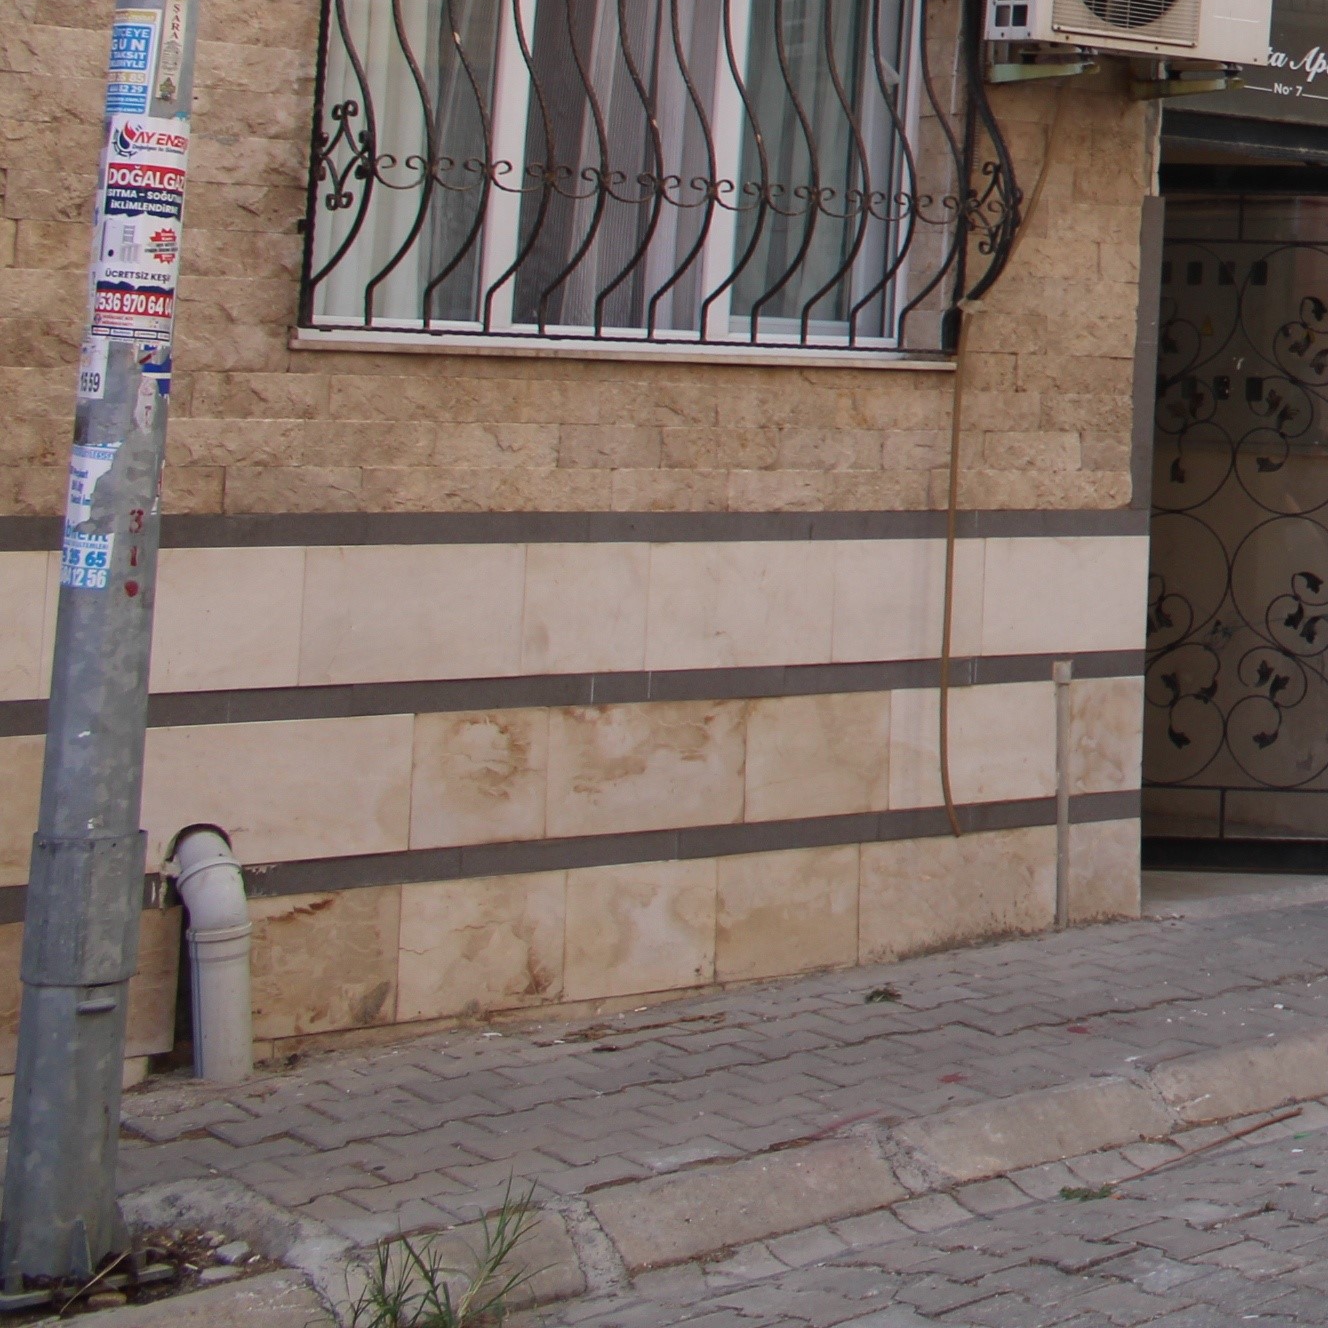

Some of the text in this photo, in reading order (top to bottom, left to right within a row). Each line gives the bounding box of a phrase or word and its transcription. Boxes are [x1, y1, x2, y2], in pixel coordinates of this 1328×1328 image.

[1295, 85, 1303, 97] 7
[107, 189, 137, 198] SITMA
[147, 188, 182, 203] SOĞUT
[105, 268, 171, 284] ÜCRETSİZ KEŞİ
[95, 292, 121, 310] 536
[123, 293, 146, 313] 970
[147, 296, 163, 315] 64
[85, 550, 107, 568] 65
[86, 569, 107, 589] 56
